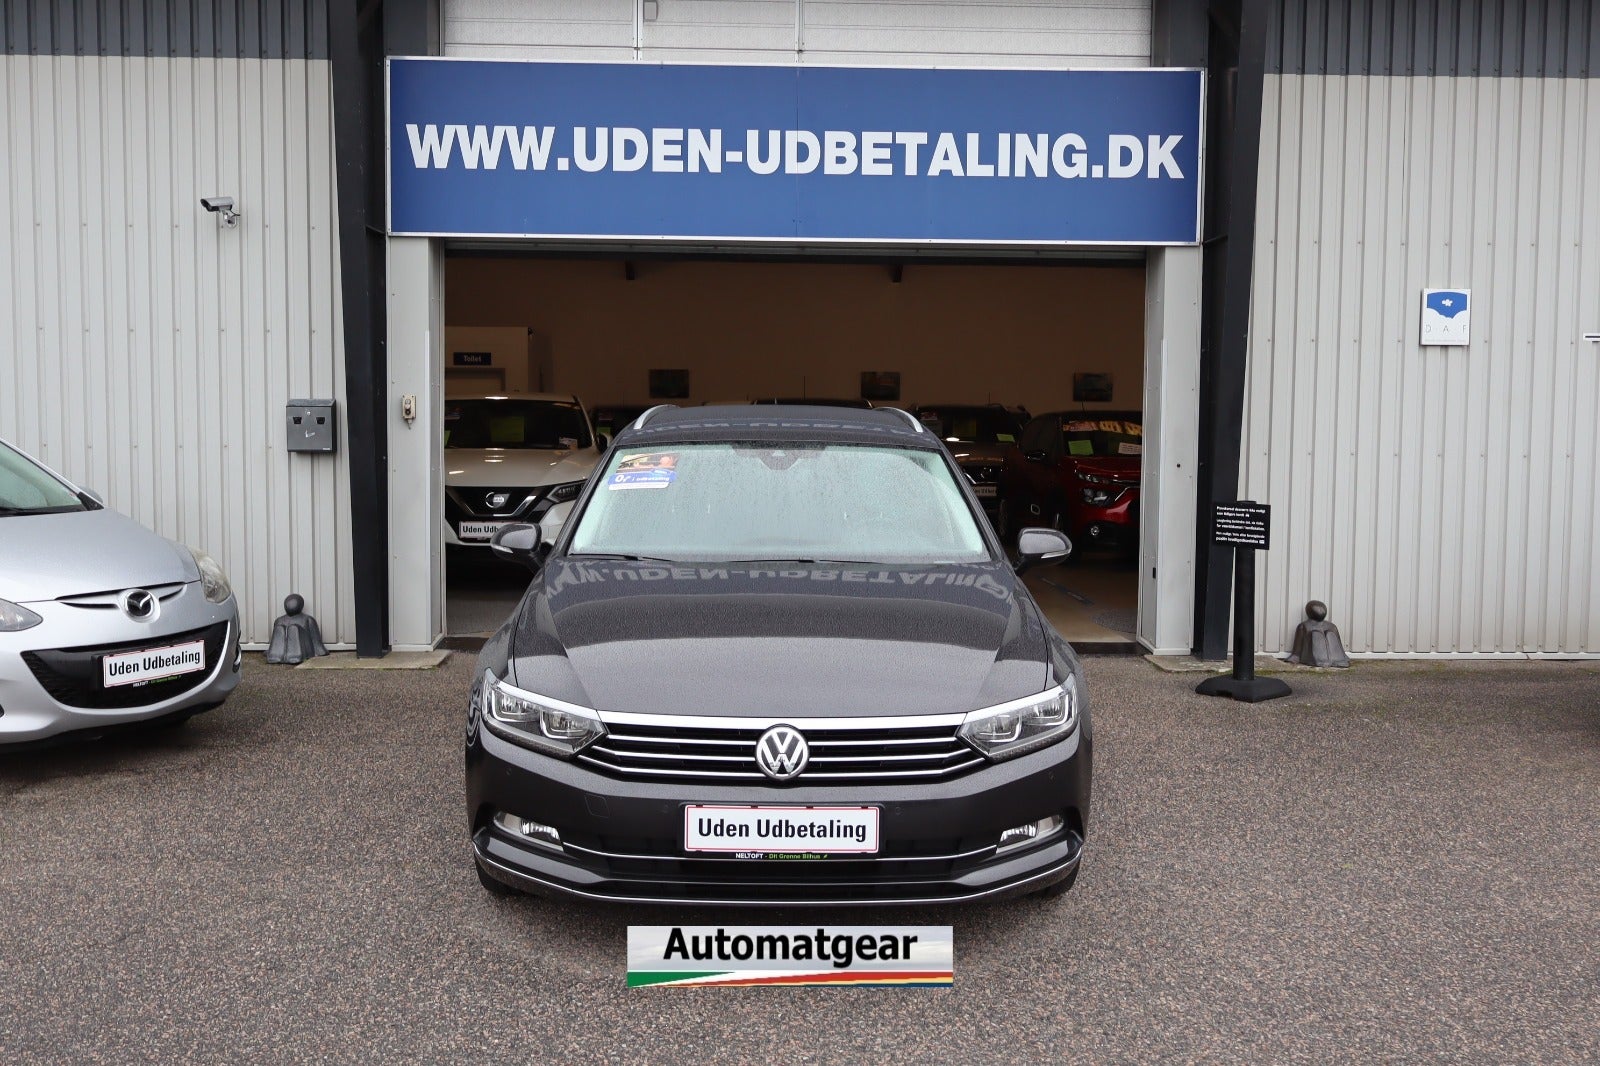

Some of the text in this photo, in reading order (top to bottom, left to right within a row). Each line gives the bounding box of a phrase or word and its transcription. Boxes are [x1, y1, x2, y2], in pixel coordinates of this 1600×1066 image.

[405, 123, 1185, 179] WWW.UDEN-UDBETALING.DK
[463, 354, 482, 362] Toilet
[109, 650, 200, 676] Uden Udbetaling
[698, 818, 866, 842] Uden Udbetaling
